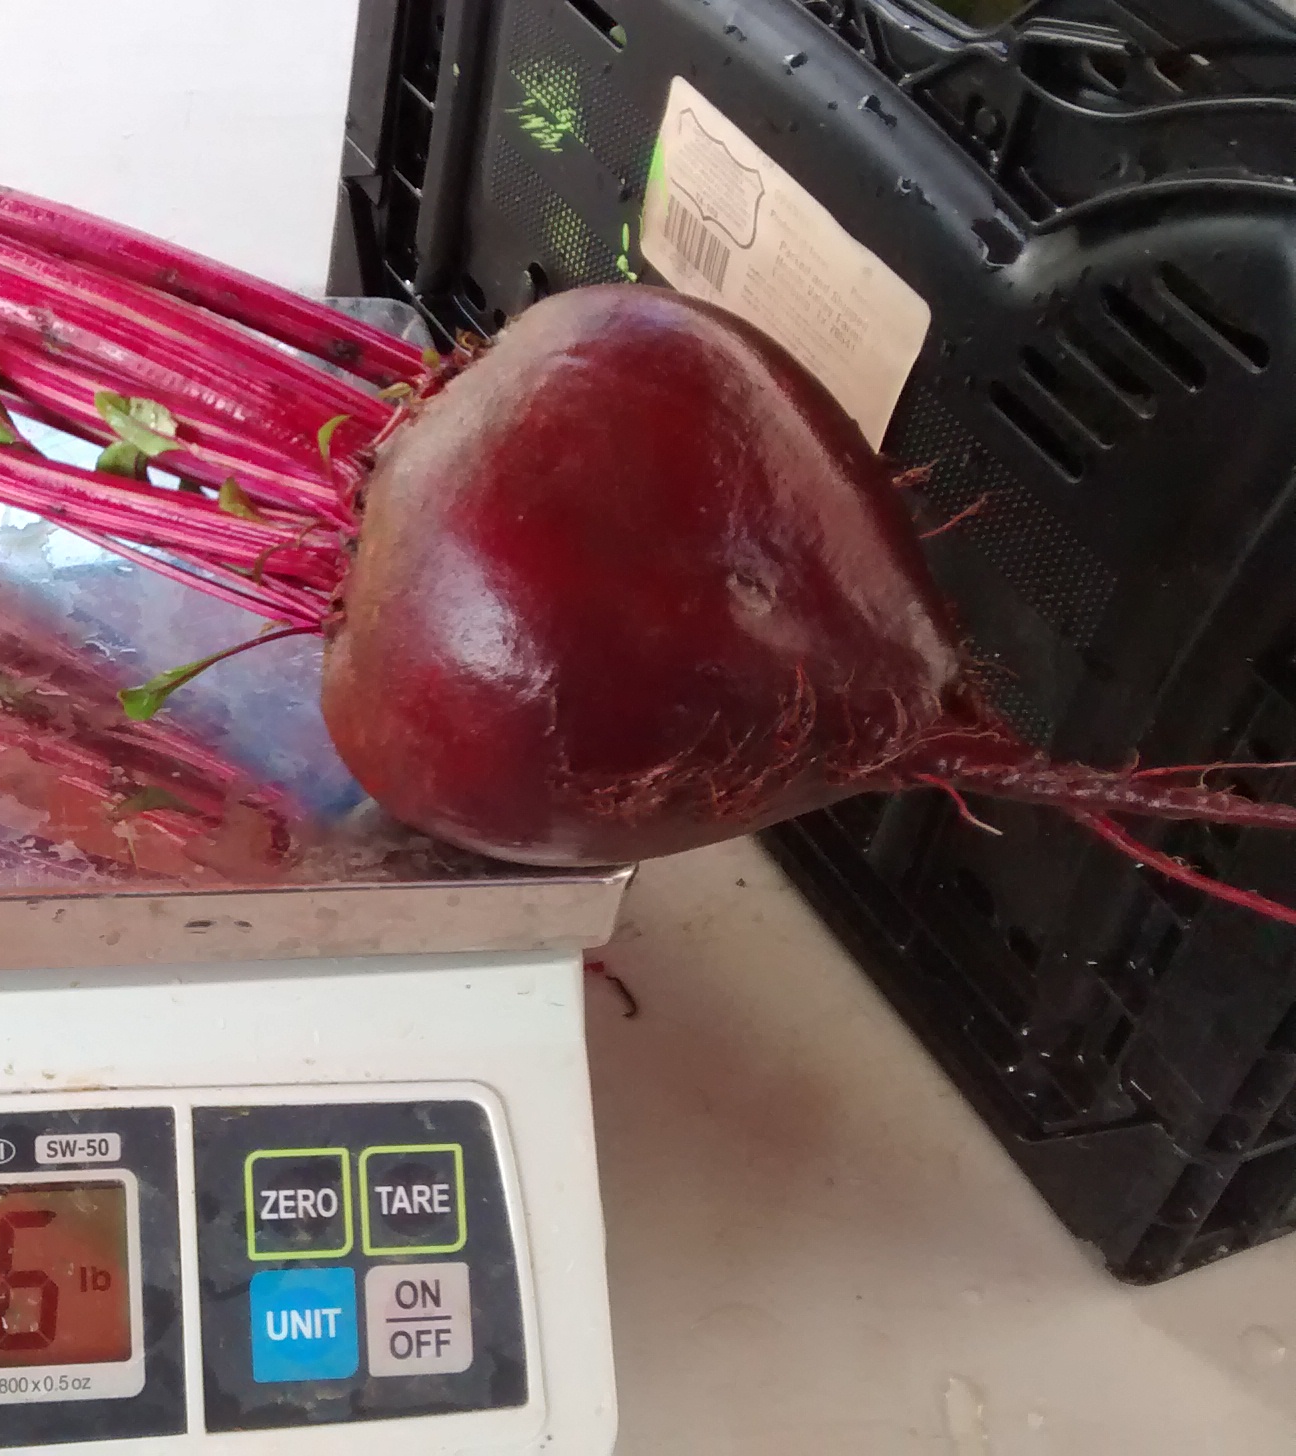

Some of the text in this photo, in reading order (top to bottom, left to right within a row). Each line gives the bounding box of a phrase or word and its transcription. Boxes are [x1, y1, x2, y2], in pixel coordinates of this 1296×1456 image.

[46, 1138, 109, 1158] SW-50
[260, 1188, 338, 1220] ZERO
[374, 1183, 451, 1216] TARE
[78, 1266, 112, 1293] lb
[395, 1279, 442, 1310] ON
[266, 1308, 342, 1341] UNIT
[389, 1328, 452, 1360] OFF
